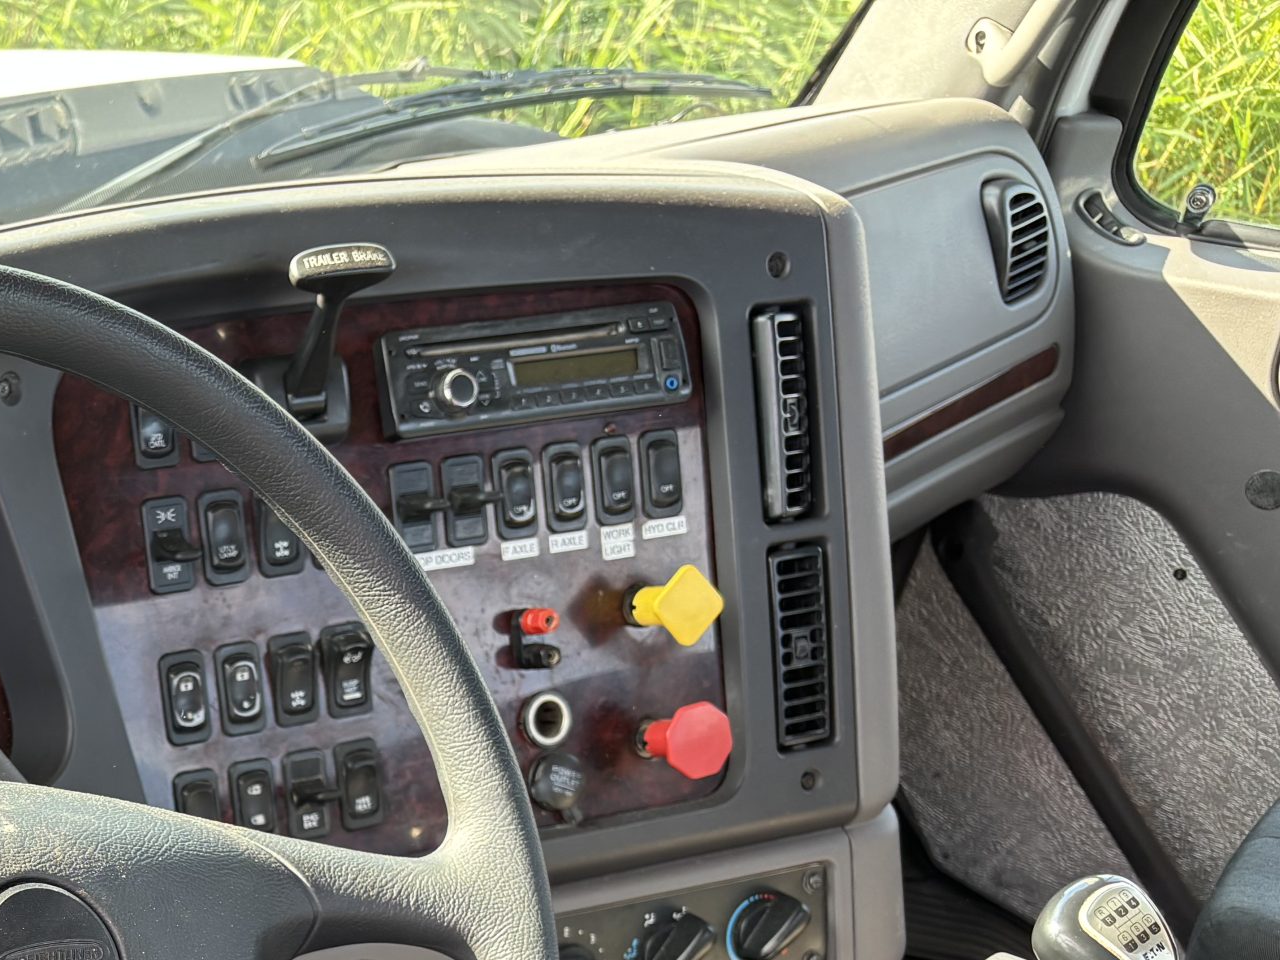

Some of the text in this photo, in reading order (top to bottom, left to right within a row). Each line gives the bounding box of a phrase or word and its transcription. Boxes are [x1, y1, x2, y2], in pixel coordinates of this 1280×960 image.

[303, 250, 387, 269] TRAILER BRAKE
[602, 528, 631, 540] WORK
[560, 535, 584, 547] AXLE
[511, 543, 536, 554] AXLE
[604, 544, 631, 556] LIGHT
